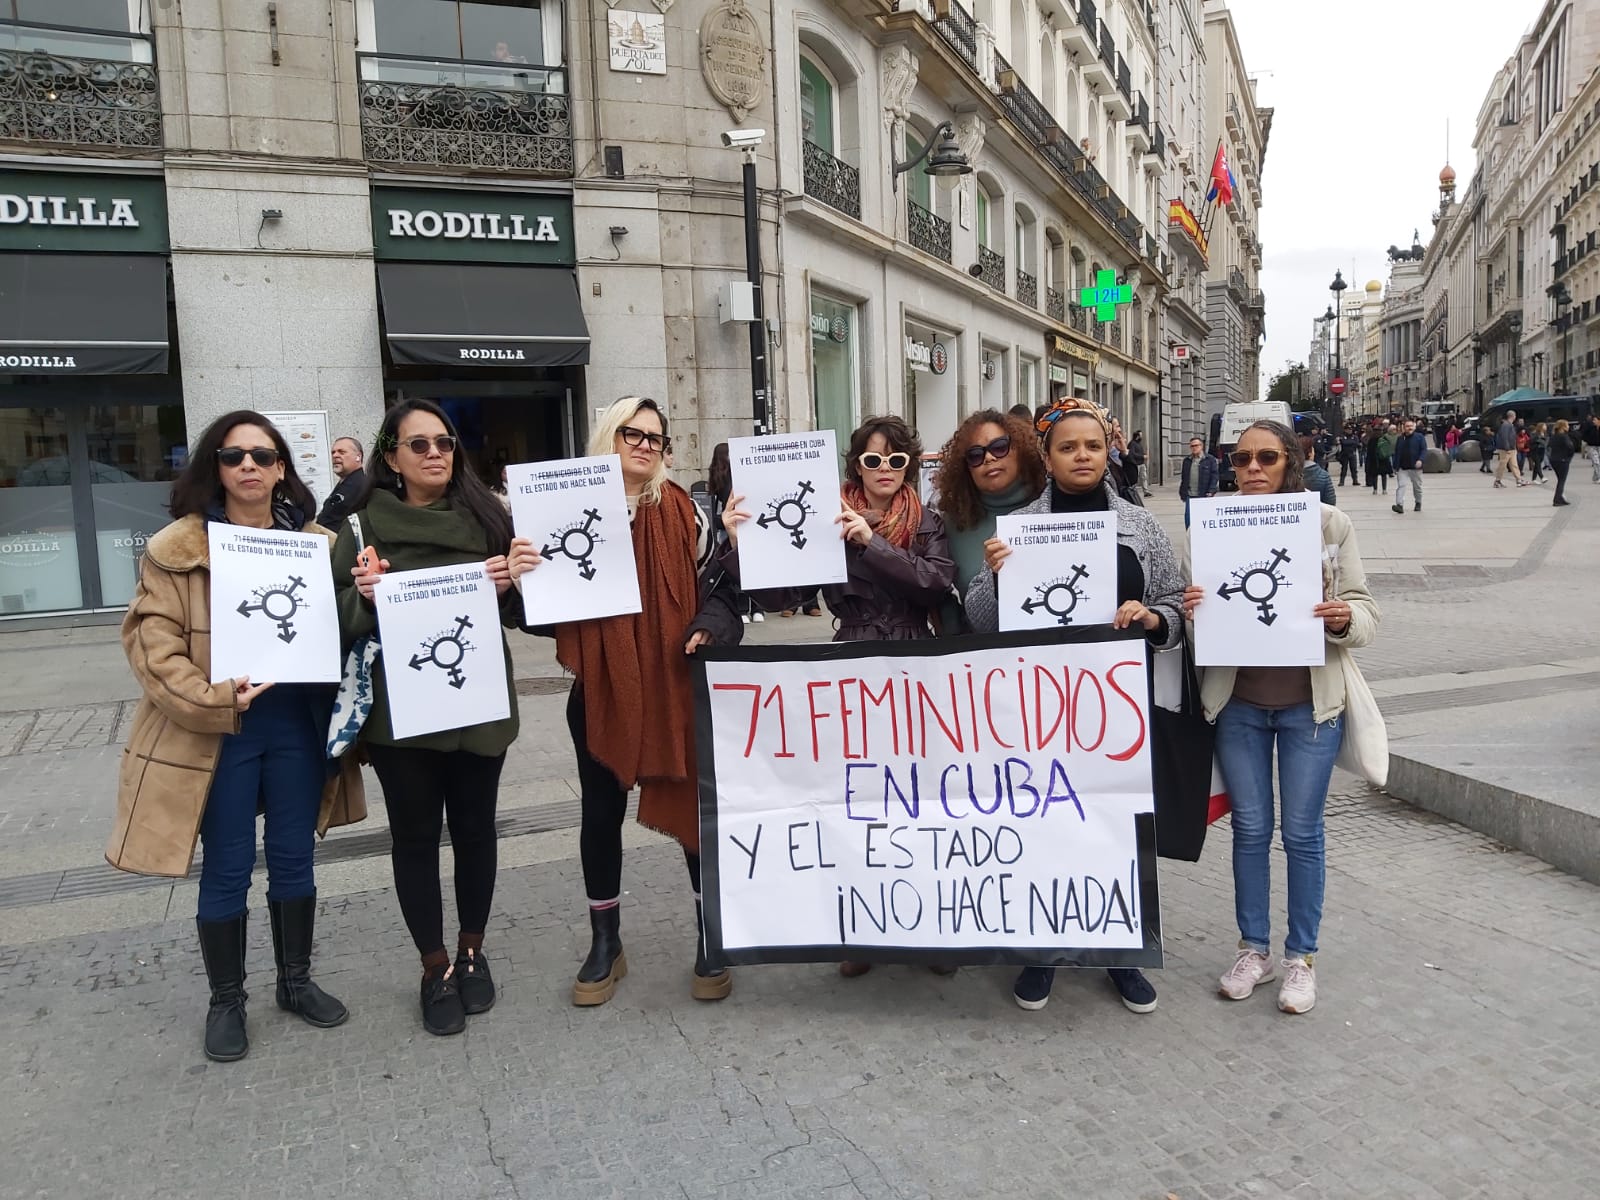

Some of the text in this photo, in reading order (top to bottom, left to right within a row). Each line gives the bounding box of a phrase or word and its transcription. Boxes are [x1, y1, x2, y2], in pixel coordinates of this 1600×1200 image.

[624, 58, 651, 70] SOL
[388, 209, 559, 241] RODILLA
[1095, 288, 1119, 303] 12H
[0, 355, 76, 367] RODILLA
[459, 348, 525, 359] RODILLA
[750, 446, 757, 454] 71
[800, 440, 808, 449] EN
[809, 438, 826, 448] CUBA
[740, 450, 821, 466] Y EL ESTADO NO HACE NADA
[530, 473, 538, 481] 71
[583, 466, 592, 475] EN
[593, 464, 611, 474] CUBA
[519, 476, 606, 494] Y EL ESTADO NO HACE NADA
[1216, 507, 1223, 516] 71
[1276, 503, 1286, 513] EN
[1287, 502, 1307, 512] CUBA
[1021, 525, 1028, 534] 71
[1077, 521, 1085, 531] EN
[1087, 520, 1105, 530] CUBA
[1202, 514, 1300, 529] Y EL ESTADO NO HACE NADA
[234, 534, 241, 542] 71
[290, 540, 298, 548] EN
[300, 540, 318, 549] CUBA
[1009, 532, 1098, 545] Y EL ESTADO NO HACE NADA
[0, 541, 61, 554] ODILLA
[221, 543, 312, 559] Y EL ESTADO NO HACE NADA
[399, 582, 407, 591] 71
[455, 574, 464, 582] EN
[465, 571, 483, 581] CUBA
[387, 583, 478, 604] Y EL ESTADO NO HACE NADA
[713, 656, 1146, 762] 71 FEMINICIDIOS
[845, 757, 1086, 822] EN CUBA
[729, 821, 1023, 879] Y EL ESTADO
[838, 859, 1140, 944] ¡NO HACE NADA!
